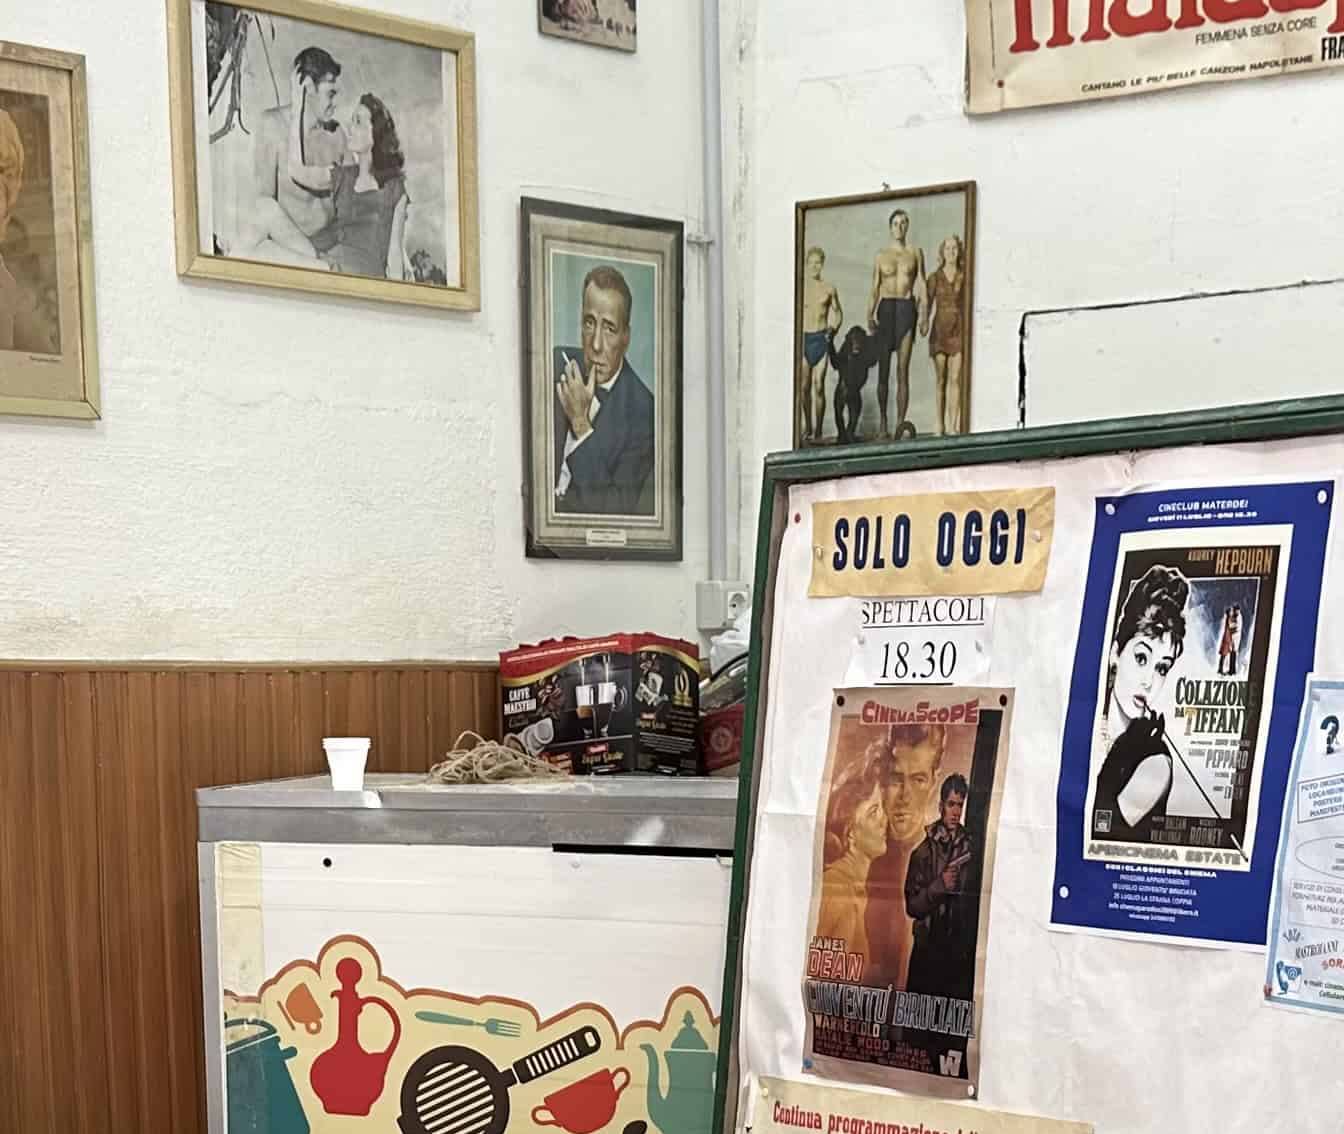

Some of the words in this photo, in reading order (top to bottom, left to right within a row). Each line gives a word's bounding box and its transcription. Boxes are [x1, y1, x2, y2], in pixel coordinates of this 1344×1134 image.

[1195, 28, 1248, 45] FEMMENA
[1251, 22, 1285, 37] SENZA
[1287, 16, 1317, 32] CORE
[833, 513, 911, 571] SOLO
[936, 508, 1026, 567] OGGI
[1215, 548, 1273, 576] HEPBURN
[862, 597, 985, 625] SPETTACOLI
[879, 640, 956, 679] 18.30
[808, 948, 864, 982] DEAN
[773, 1101, 823, 1130] Continua
